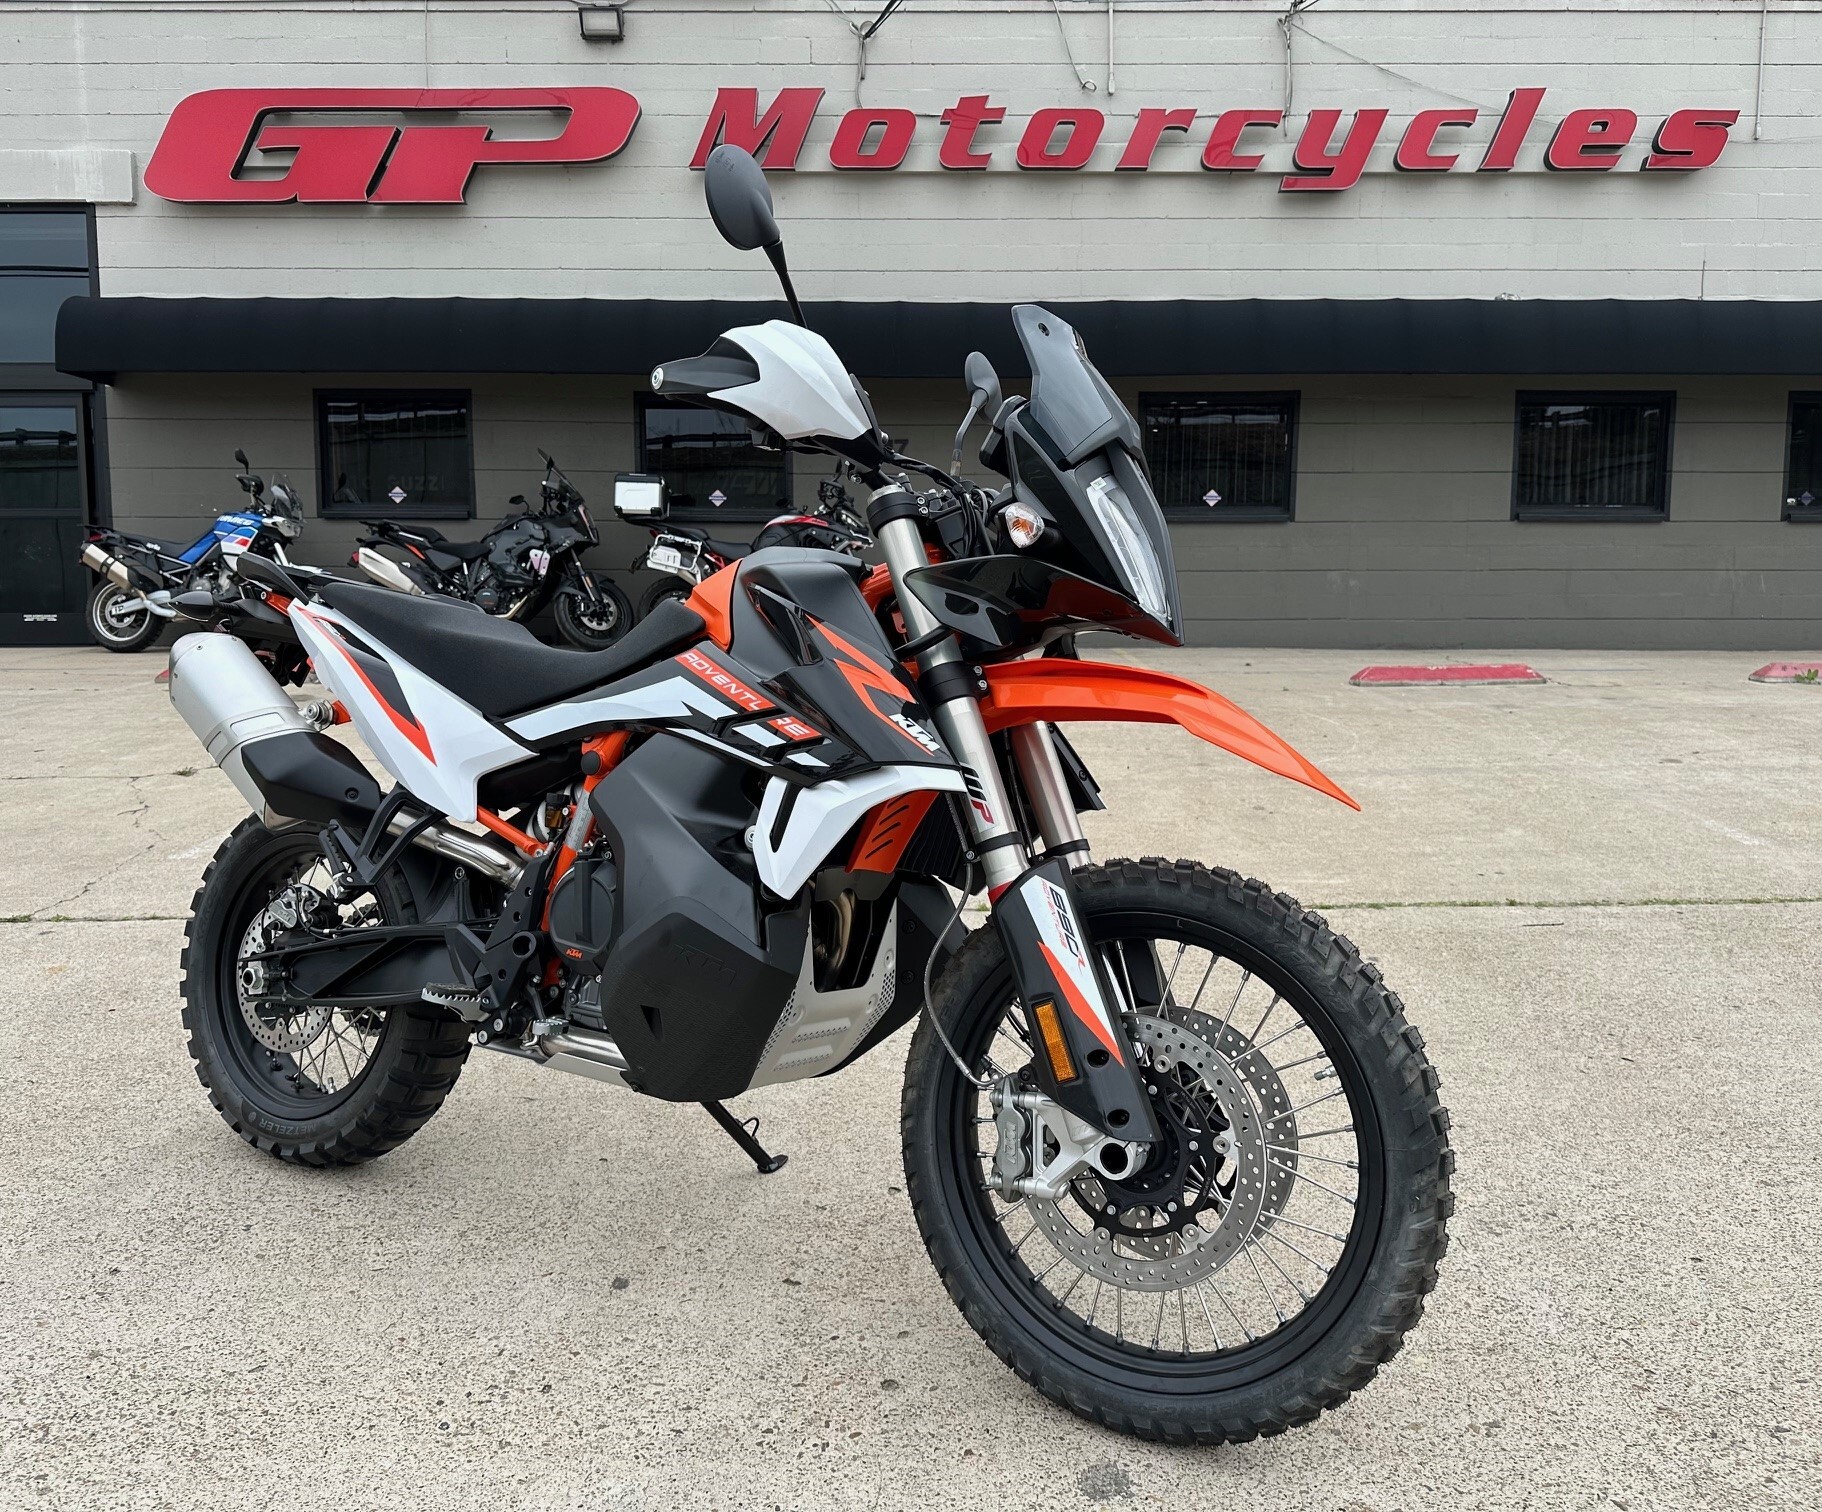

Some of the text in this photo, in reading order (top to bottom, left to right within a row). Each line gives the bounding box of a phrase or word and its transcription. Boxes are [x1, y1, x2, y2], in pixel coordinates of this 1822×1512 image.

[143, 86, 1740, 204] GP Motorcycles
[888, 713, 941, 752] KTM
[565, 947, 583, 959] KTM
[258, 1118, 317, 1135] METZELER
